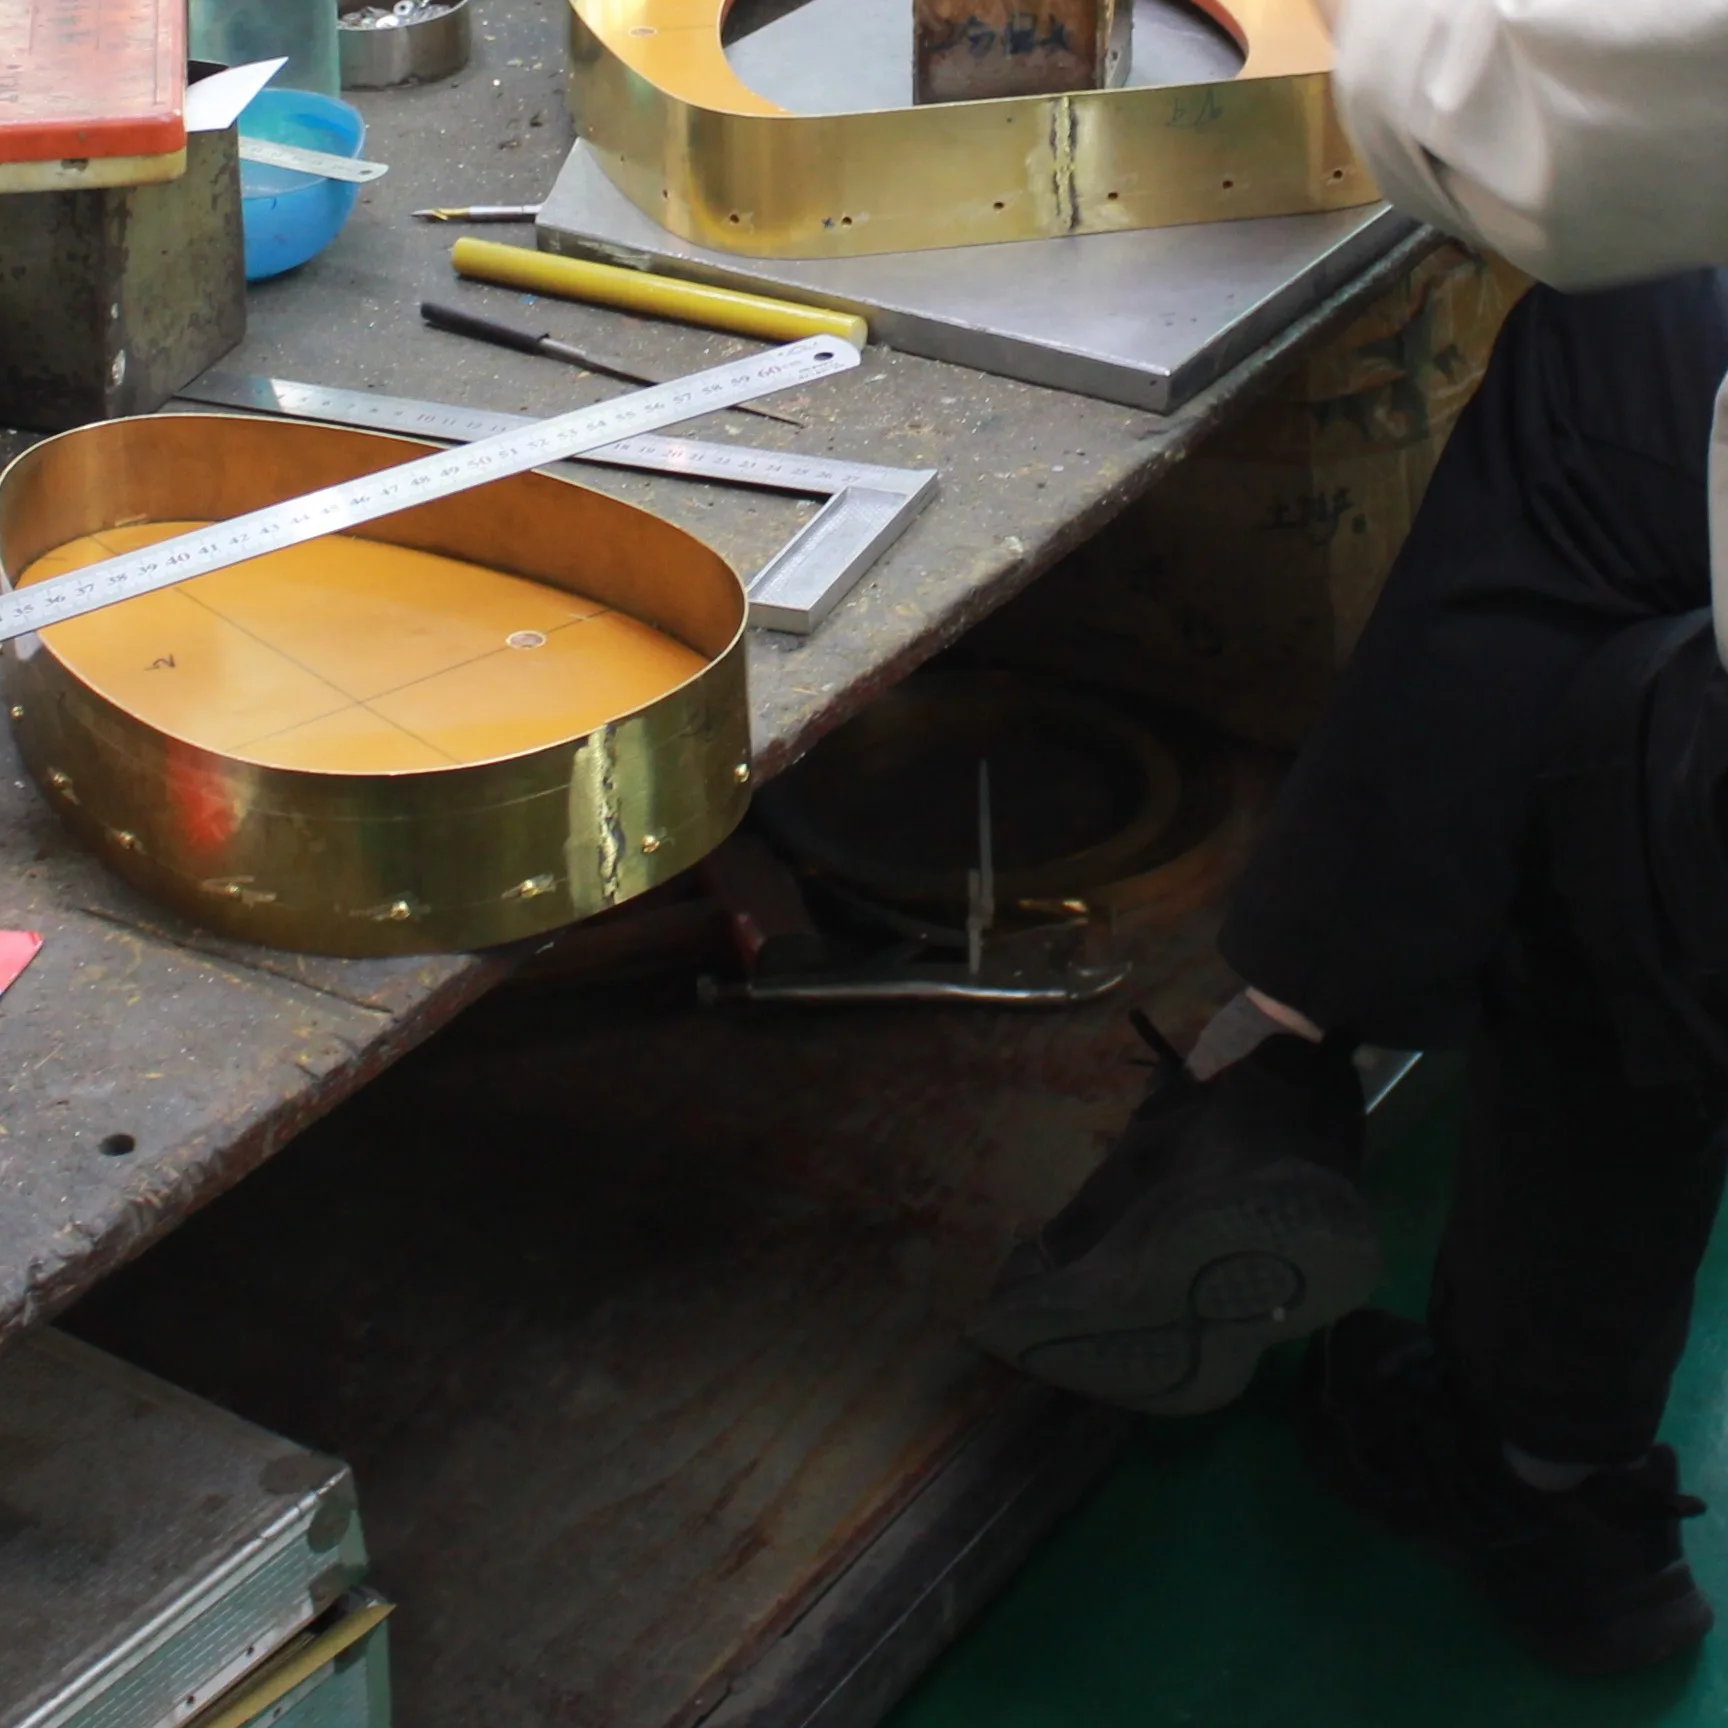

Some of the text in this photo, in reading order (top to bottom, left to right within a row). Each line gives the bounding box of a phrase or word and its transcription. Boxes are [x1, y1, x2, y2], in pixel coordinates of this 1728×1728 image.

[12, 605, 34, 618] 35
[44, 595, 66, 607] 36
[75, 583, 95, 597] 37
[107, 573, 128, 586] 38
[137, 563, 158, 576] 39
[166, 552, 191, 566] 40
[198, 543, 218, 555] 41
[229, 533, 250, 545] 42
[467, 455, 492, 468] 50
[528, 438, 550, 450] 52
[644, 401, 665, 413] 56
[673, 391, 693, 405] 57
